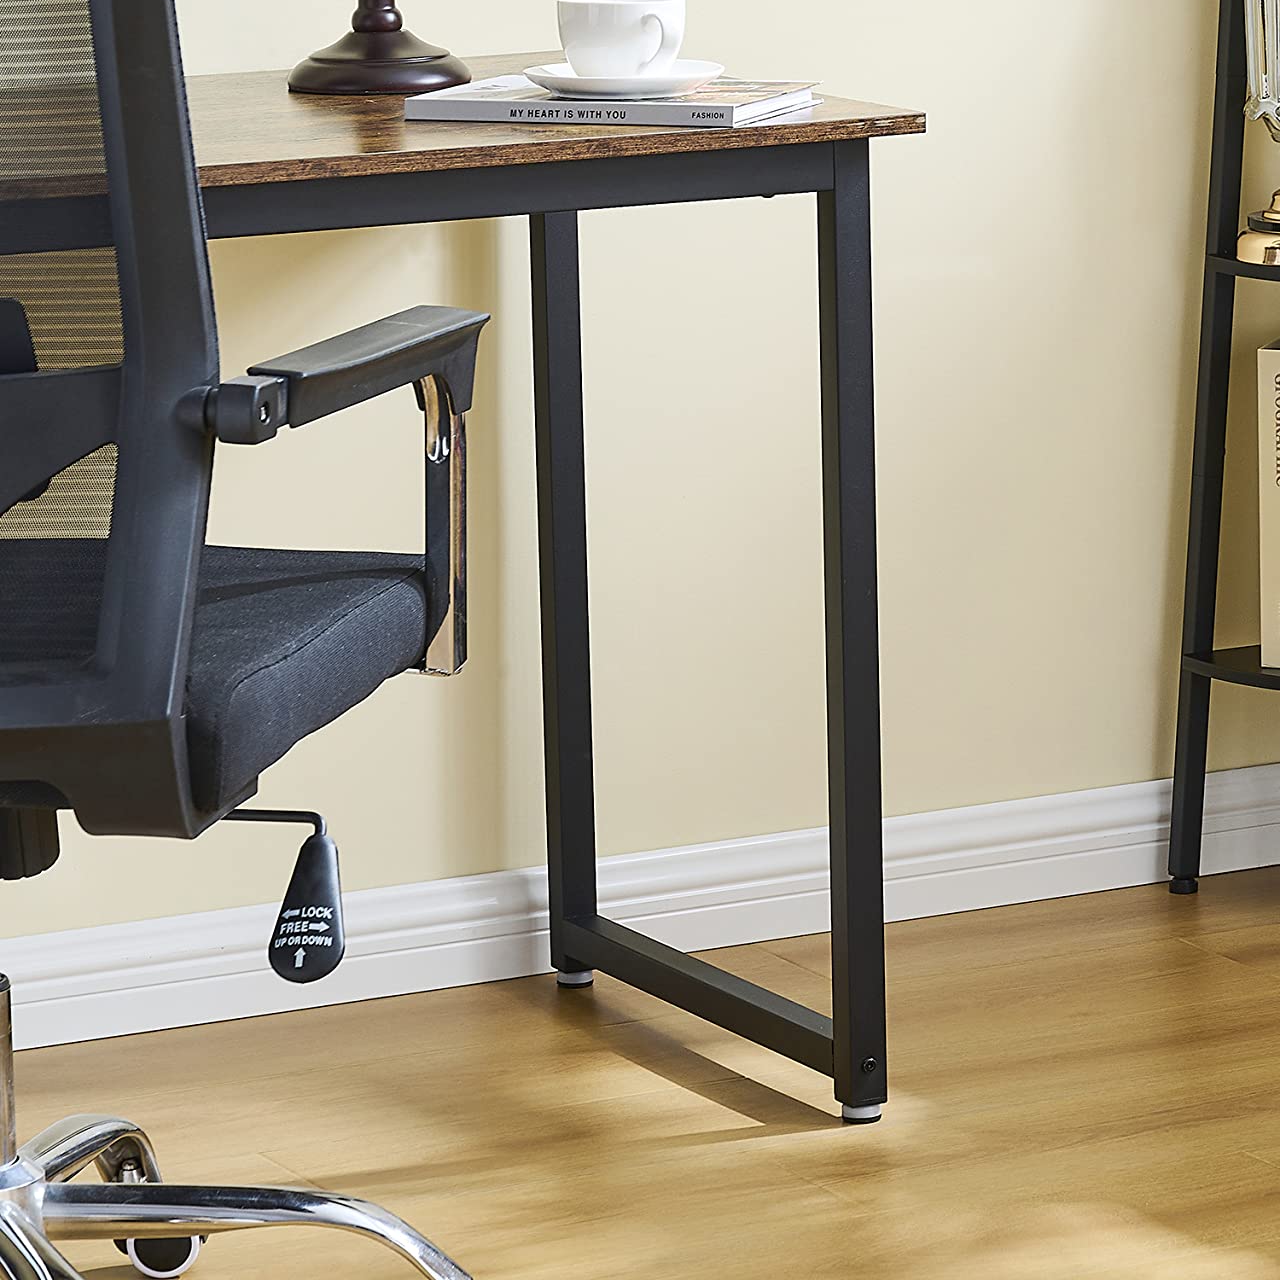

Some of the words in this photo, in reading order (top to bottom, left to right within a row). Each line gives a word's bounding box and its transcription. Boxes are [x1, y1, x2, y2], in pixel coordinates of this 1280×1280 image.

[510, 109, 524, 118] MY
[527, 109, 560, 118] HEART
[564, 109, 574, 119] IS
[577, 110, 602, 119] WITH
[605, 110, 626, 120] YOU
[691, 111, 725, 119] FASHION
[301, 906, 334, 919] LOCK
[279, 921, 309, 935] FREE
[274, 937, 287, 948] UP
[287, 936, 301, 946] OR
[301, 935, 333, 947] DOWN
